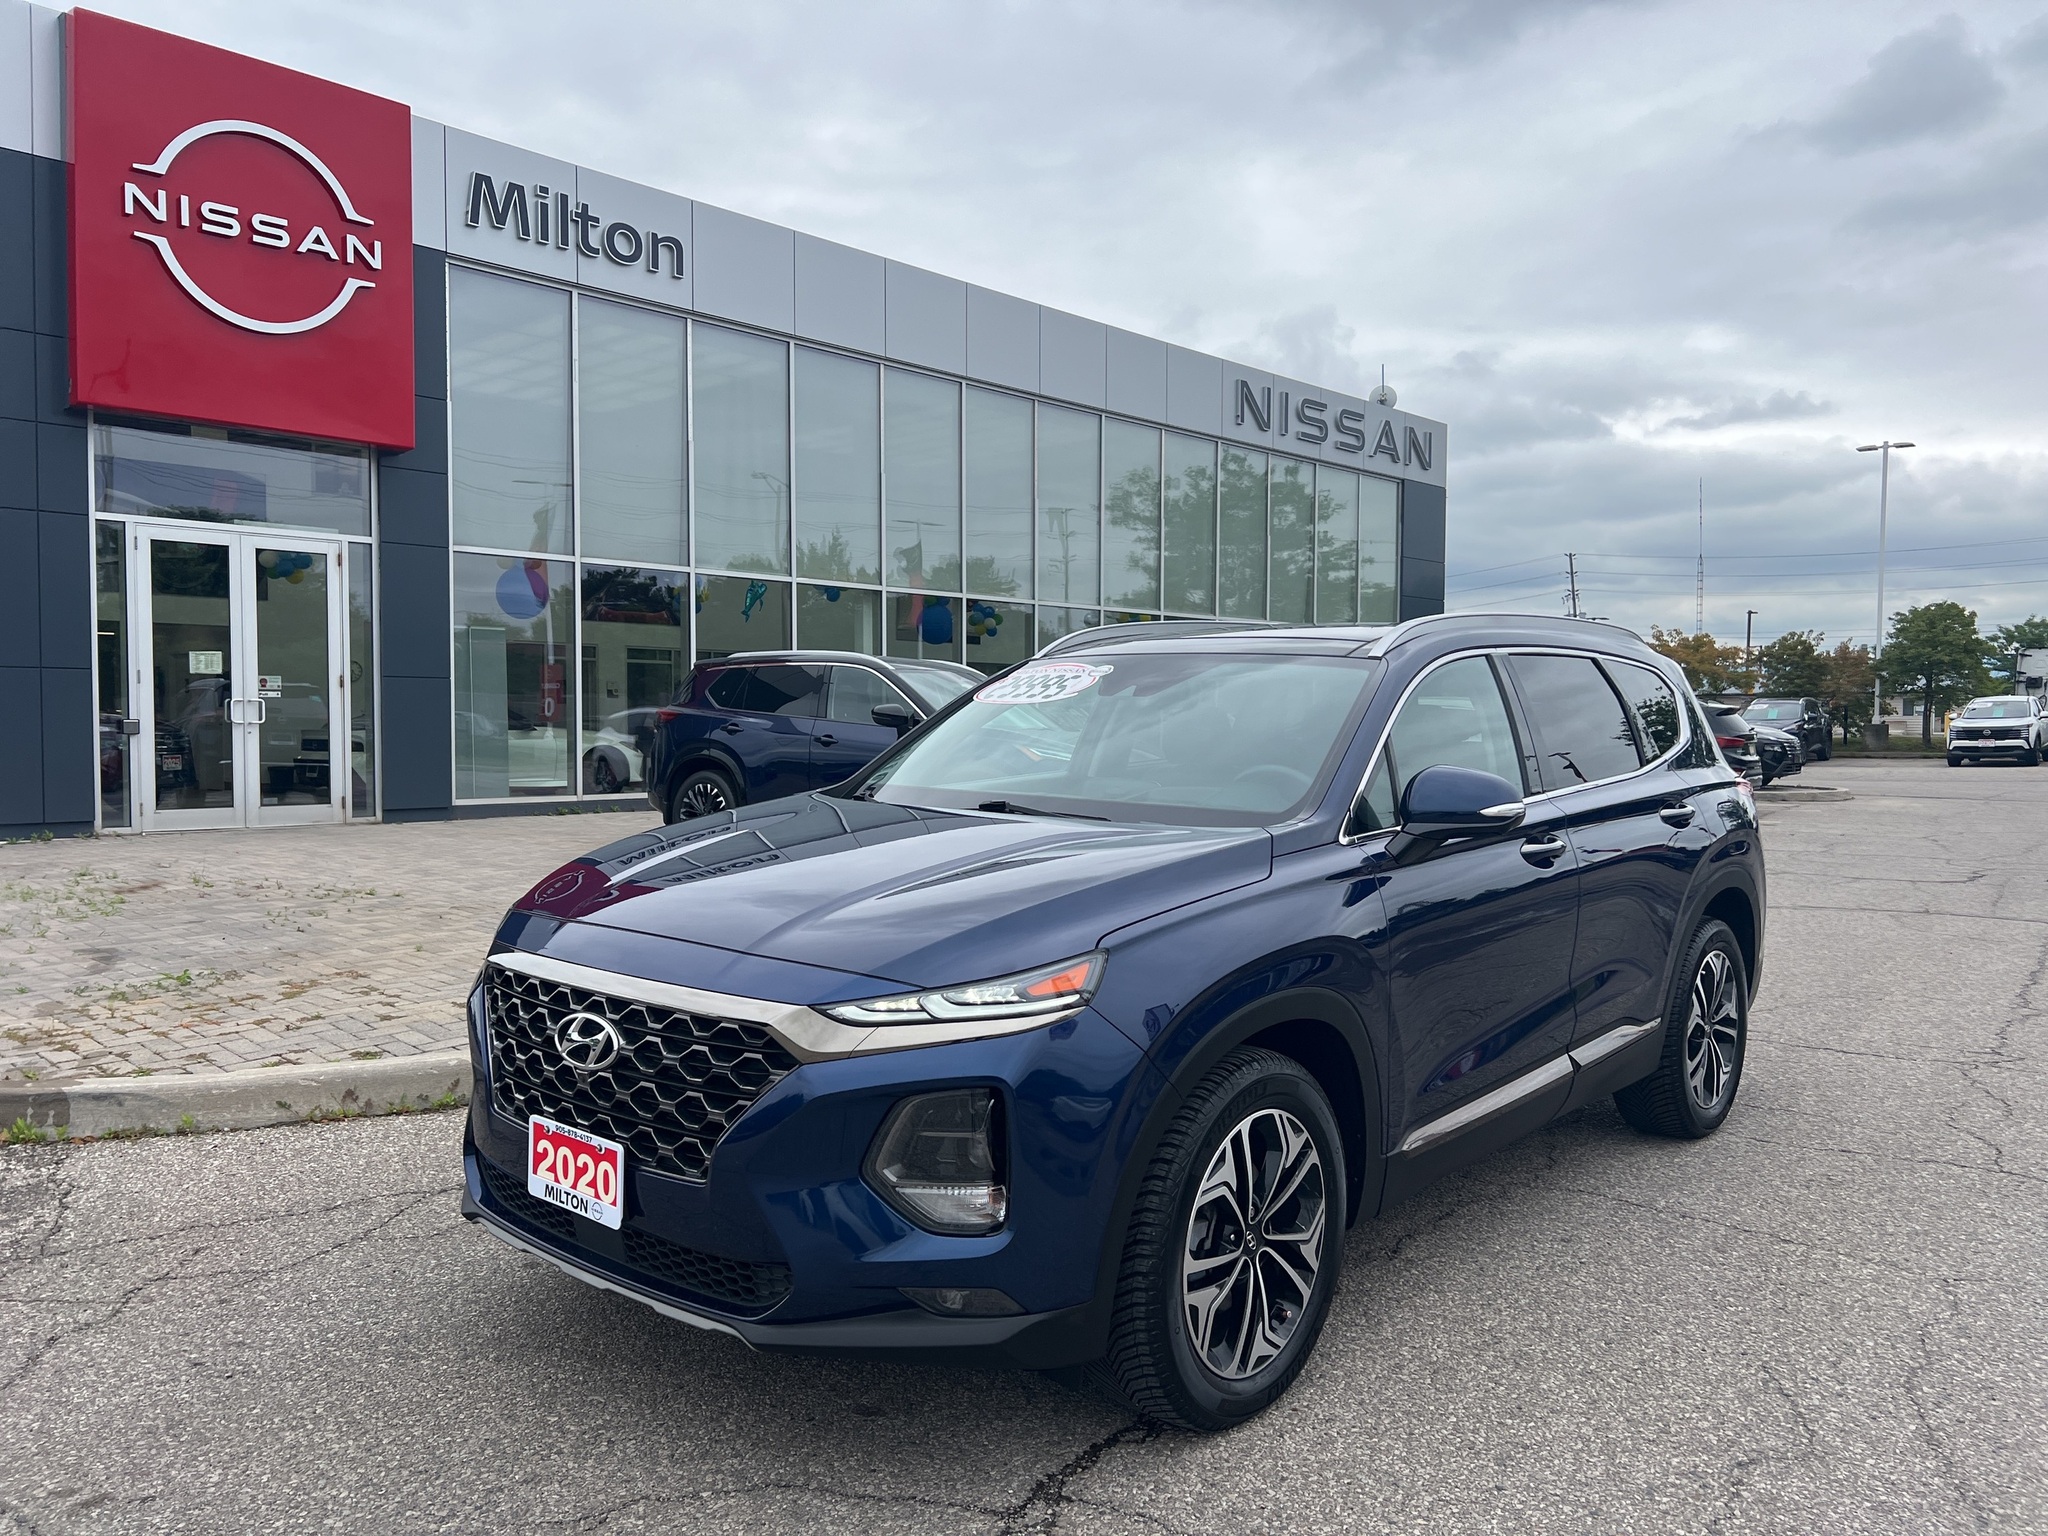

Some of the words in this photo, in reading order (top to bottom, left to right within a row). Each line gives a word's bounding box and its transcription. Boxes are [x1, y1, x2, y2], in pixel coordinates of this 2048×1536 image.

[123, 181, 383, 271] NISSAN
[467, 170, 685, 280] Milton
[1236, 378, 1432, 470] NISSAN
[536, 1138, 616, 1205] 2020
[554, 1124, 593, 1144] 905-878-4137
[544, 1184, 589, 1214] MILTON
